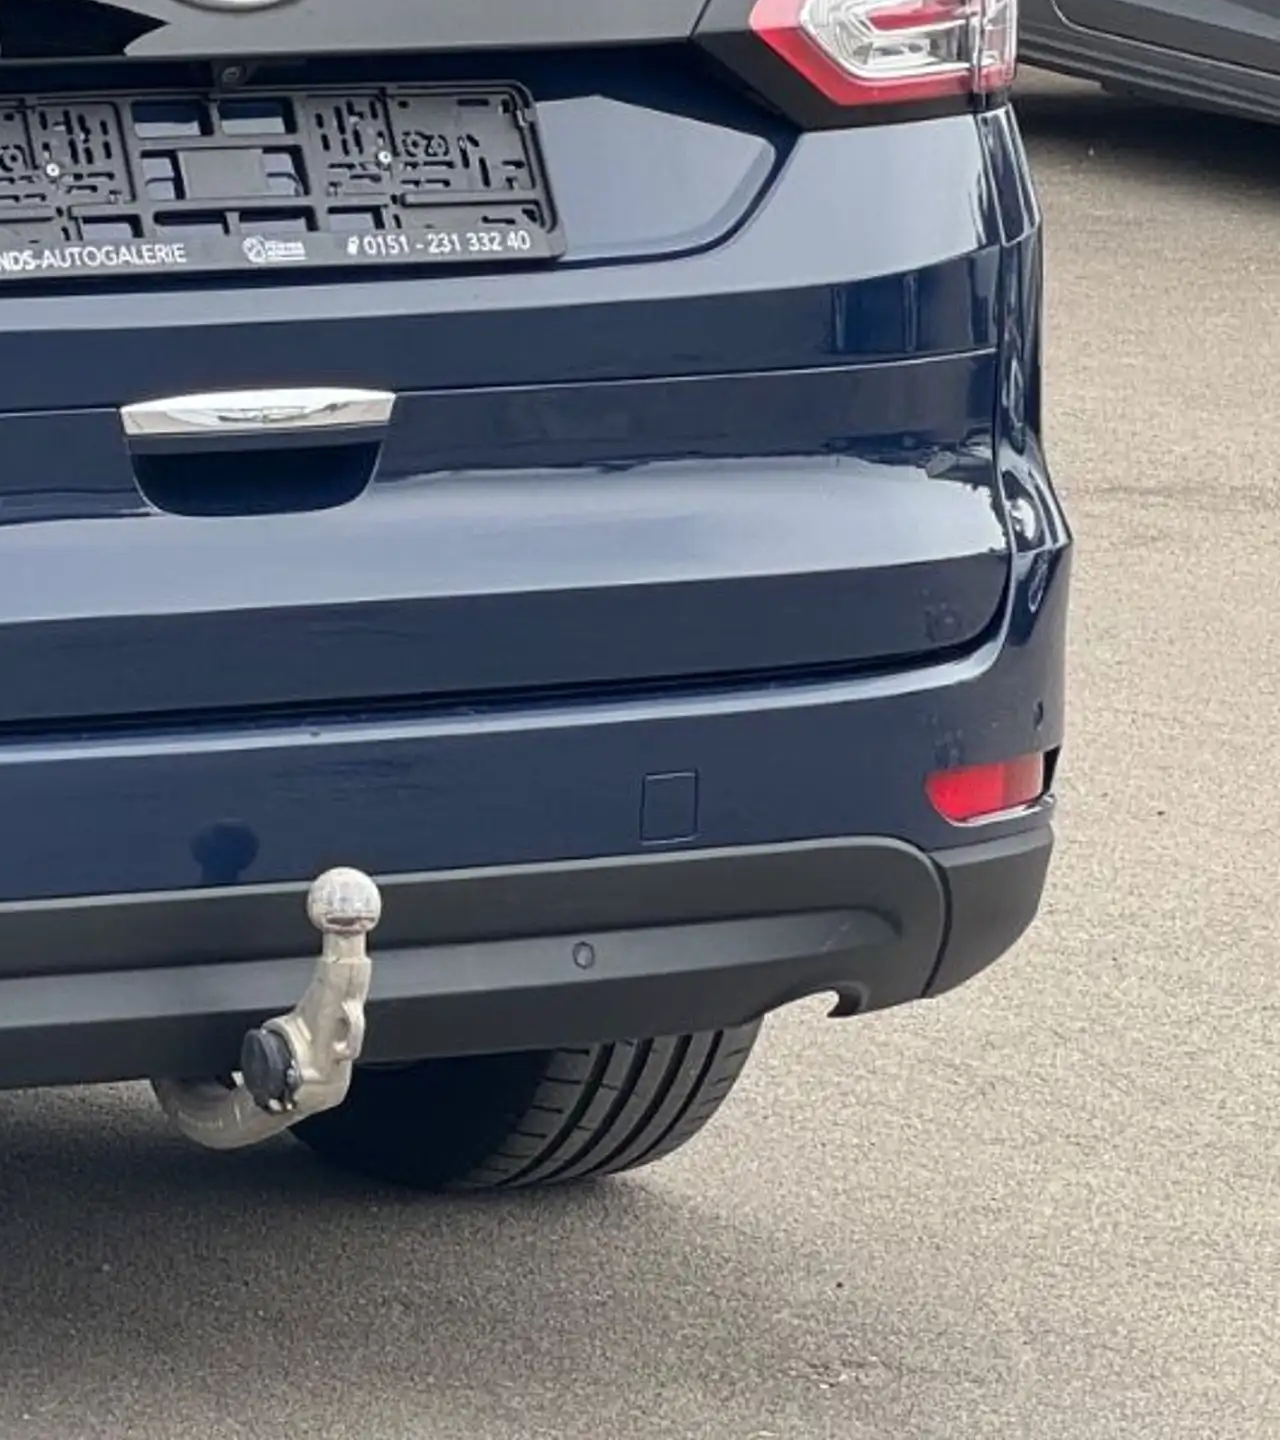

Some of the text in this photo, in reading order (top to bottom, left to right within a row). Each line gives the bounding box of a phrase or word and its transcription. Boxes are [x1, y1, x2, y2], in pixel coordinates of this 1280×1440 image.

[363, 234, 410, 257] 0151
[427, 233, 461, 254] 231
[466, 232, 503, 252] 332
[507, 230, 531, 250] 40
